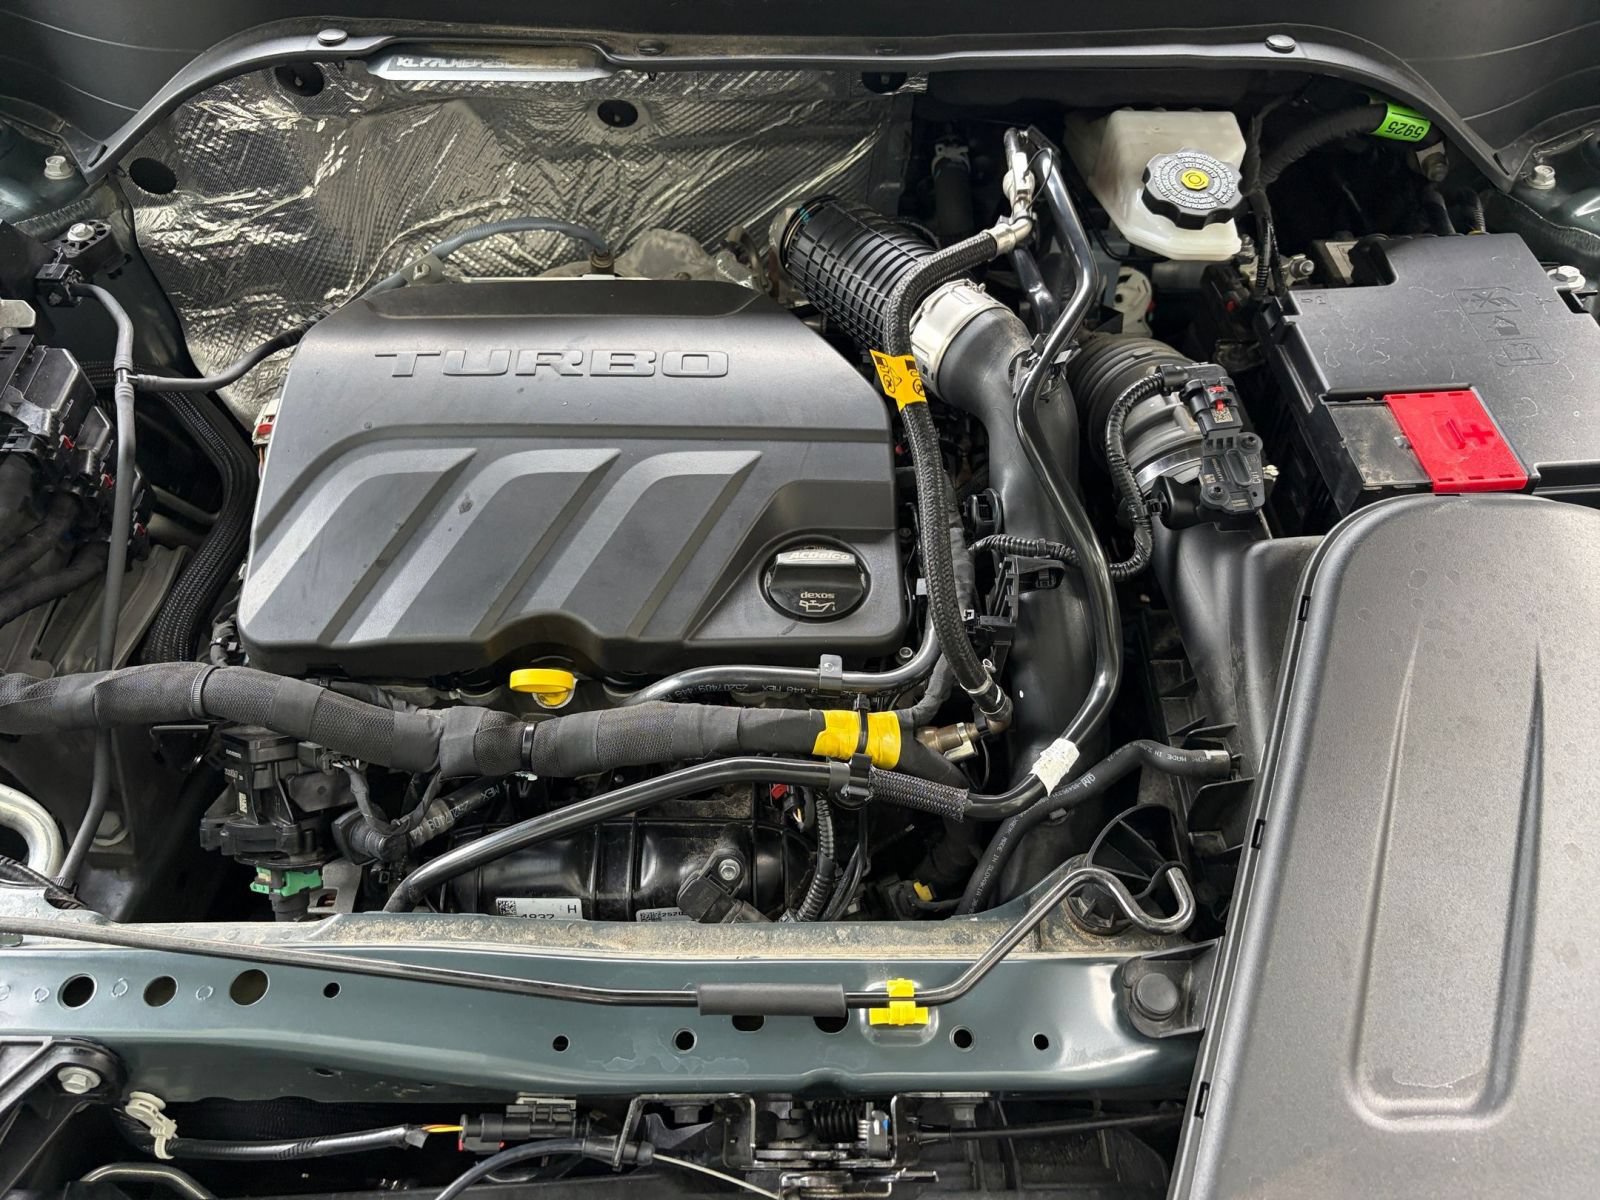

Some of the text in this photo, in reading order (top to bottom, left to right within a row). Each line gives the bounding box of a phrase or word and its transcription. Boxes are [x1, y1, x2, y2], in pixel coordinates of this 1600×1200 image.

[1385, 121, 1425, 139] 5925
[375, 349, 729, 379] TURBO
[788, 551, 851, 560] ACDelco
[800, 591, 835, 599] dexos
[566, 904, 577, 914] H
